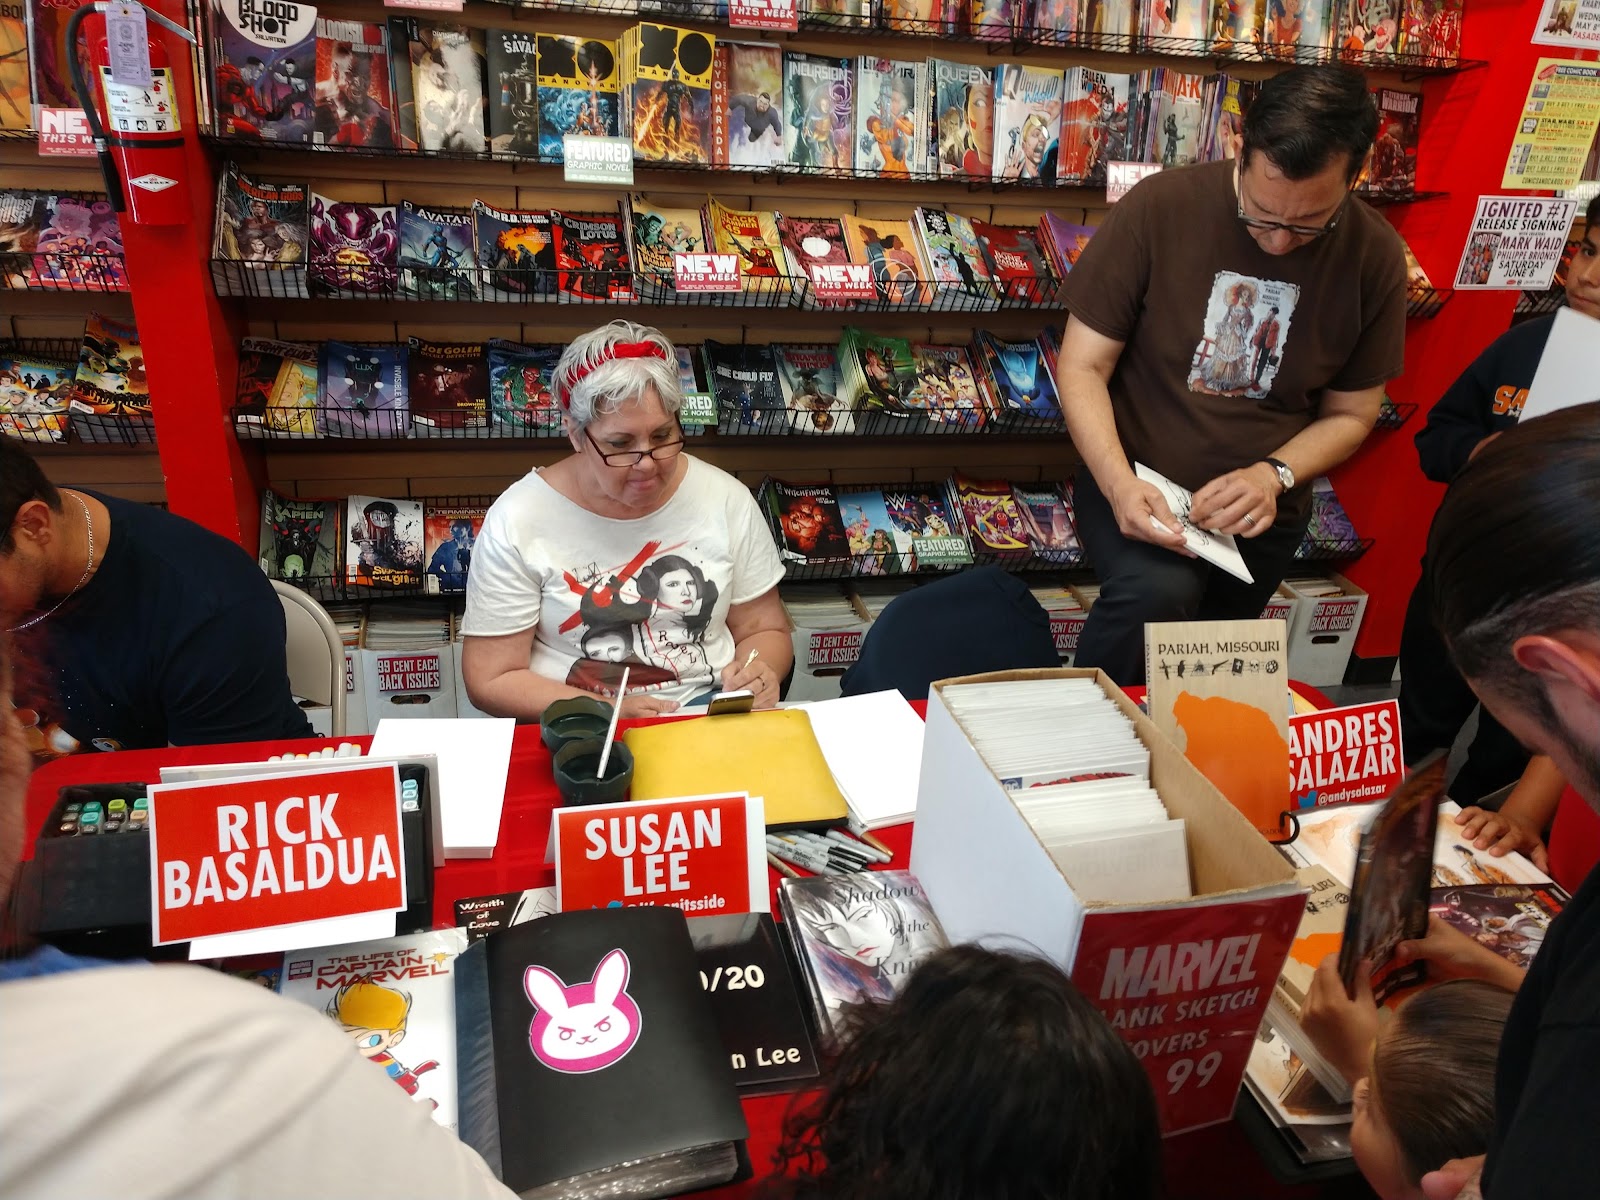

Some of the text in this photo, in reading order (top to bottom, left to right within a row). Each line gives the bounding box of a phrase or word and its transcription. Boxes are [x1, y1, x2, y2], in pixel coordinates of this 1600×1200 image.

[732, 6, 794, 19] THIS WEEK
[239, 13, 290, 37] SHOT
[789, 60, 848, 86] INCURSION
[939, 64, 992, 85] QUEEN
[1082, 68, 1106, 84] FALLEN
[1382, 98, 1418, 113] WARRIOR
[715, 94, 723, 155] HARADA
[43, 135, 75, 144] THIS
[567, 141, 631, 163] FEATURED
[567, 161, 631, 172] GRAPHIC NOVEL
[417, 208, 472, 226] AVATAR
[720, 208, 756, 225] BLACK
[1481, 201, 1569, 219] IGNITED #1
[564, 217, 616, 232] CRIMSON
[1476, 218, 1566, 231] RELEASE SIGNING
[580, 229, 617, 240] LOTUS
[1499, 236, 1562, 251] MARK WAID
[642, 254, 675, 269] HAMME
[676, 254, 738, 273] NEW
[1496, 251, 1557, 261] PHILIPPE BRIONES
[1498, 260, 1545, 269] SATURDAY
[708, 274, 738, 282] WEEK
[812, 266, 870, 283] NEW
[1503, 269, 1535, 278] JUNE 8
[815, 281, 873, 290] THIS WEEK
[421, 345, 442, 353] JOE
[394, 365, 402, 395] INVISIBLE
[732, 370, 758, 382] COULD
[759, 372, 774, 382] FLY
[1492, 385, 1530, 415] SA
[784, 487, 831, 497] WITCHFINDER
[275, 503, 324, 522] SAPIEN
[914, 538, 966, 552] FEATURED
[1325, 604, 1341, 616] CENT
[1342, 603, 1357, 616] EACH
[1068, 619, 1084, 633] EAC
[1311, 616, 1354, 630] BACK ISSUES
[810, 634, 861, 648] 99 CENT EACH
[1056, 634, 1079, 649] ISSUE
[1158, 640, 1280, 656] PARIAH, MISSOURI
[809, 648, 860, 664] BACK ISSUES
[378, 658, 439, 673] 99 CENT EACH
[380, 671, 440, 690] BACK ISSUES
[1289, 709, 1394, 758] ANDRES
[1318, 784, 1387, 806] @andysalazar
[217, 793, 341, 853] RICK
[584, 808, 722, 861] SUSAN
[163, 834, 397, 910] BASALDUA
[623, 851, 691, 897] LEE
[835, 883, 918, 905] Shadow
[459, 899, 505, 911] Wraith
[476, 912, 490, 920] of
[469, 920, 500, 929] Love
[908, 920, 930, 932] the
[328, 949, 417, 965] THE LIFE OF
[317, 955, 423, 976] CAPTAIN
[1100, 934, 1262, 1000] MARVEL
[316, 964, 450, 991] MARVEL
[1175, 986, 1260, 1022] SKETCH
[757, 1046, 801, 1068] Lee
